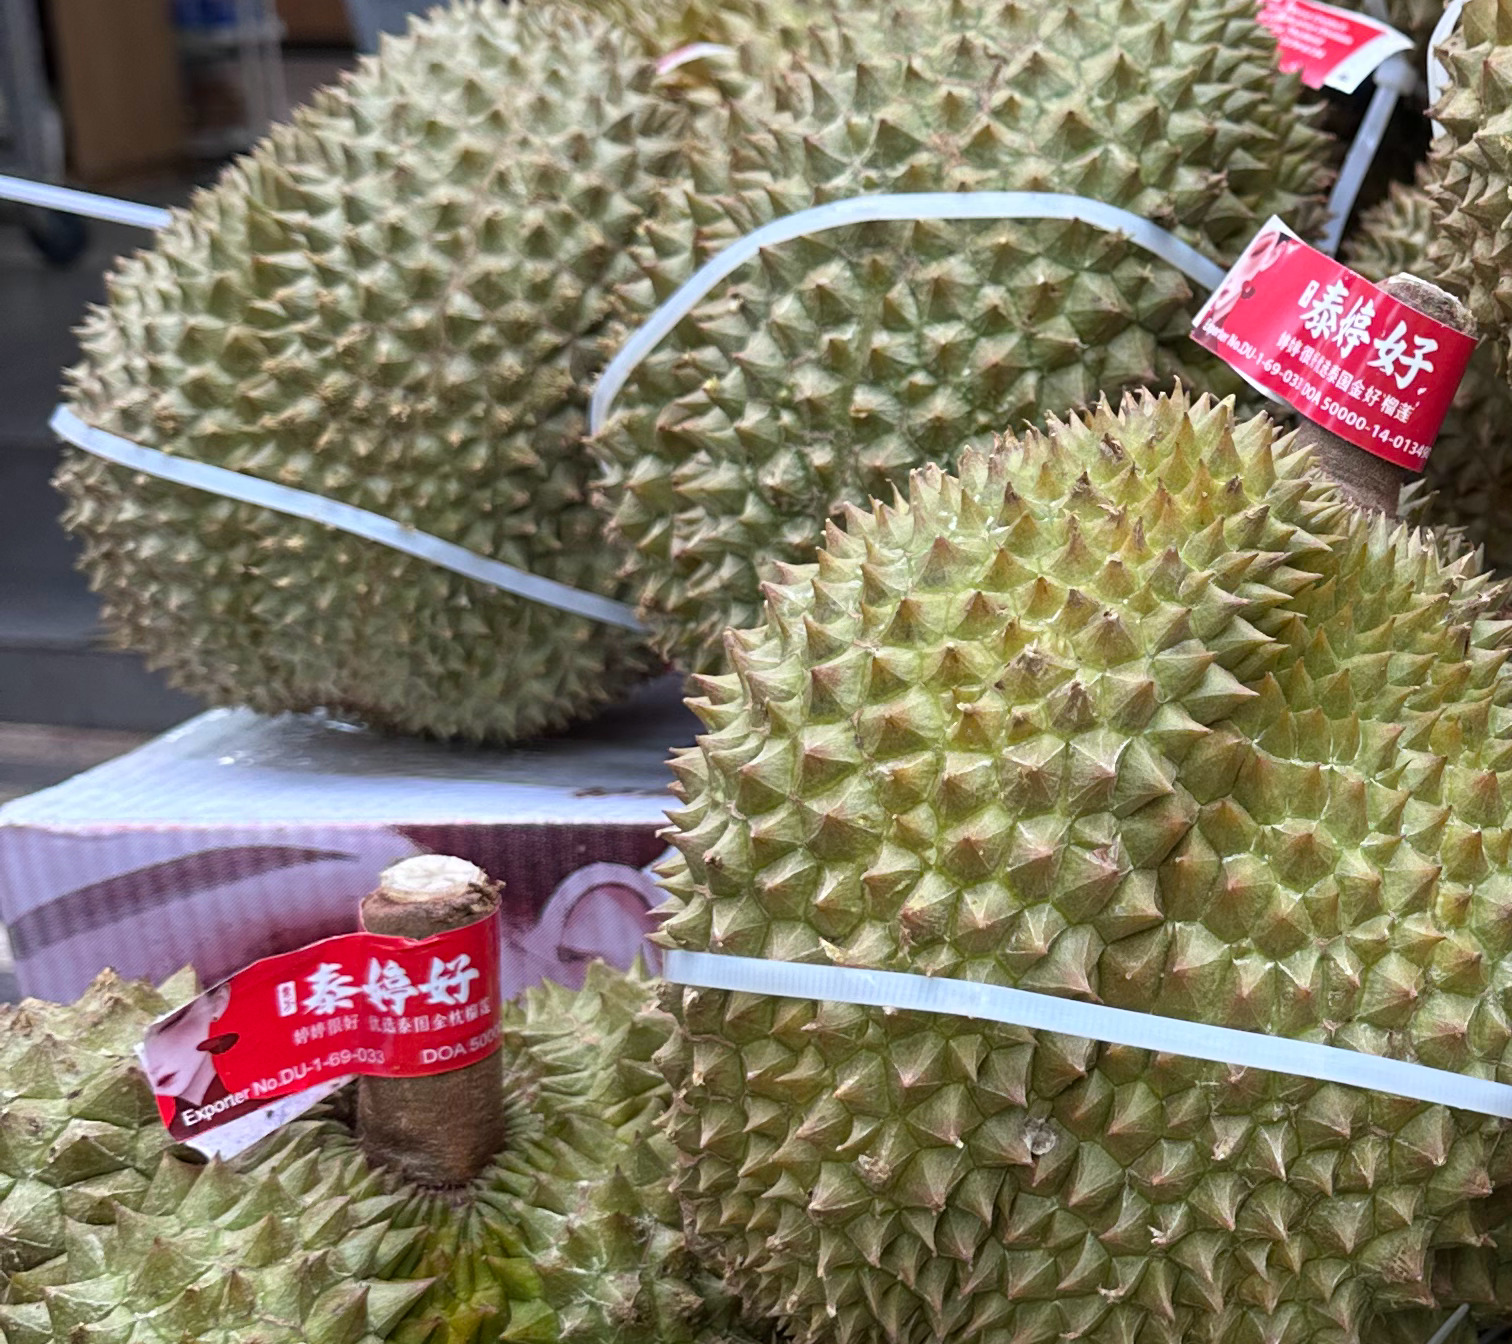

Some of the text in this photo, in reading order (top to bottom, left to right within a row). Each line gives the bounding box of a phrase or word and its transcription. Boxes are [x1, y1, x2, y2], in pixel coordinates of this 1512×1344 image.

[1300, 280, 1438, 390] 泰婷好
[303, 954, 480, 1016] 泰婷好
[181, 1085, 251, 1128] Exporter
[253, 1046, 386, 1096] No.DU-1-69-033
[421, 1042, 468, 1066] DOA
